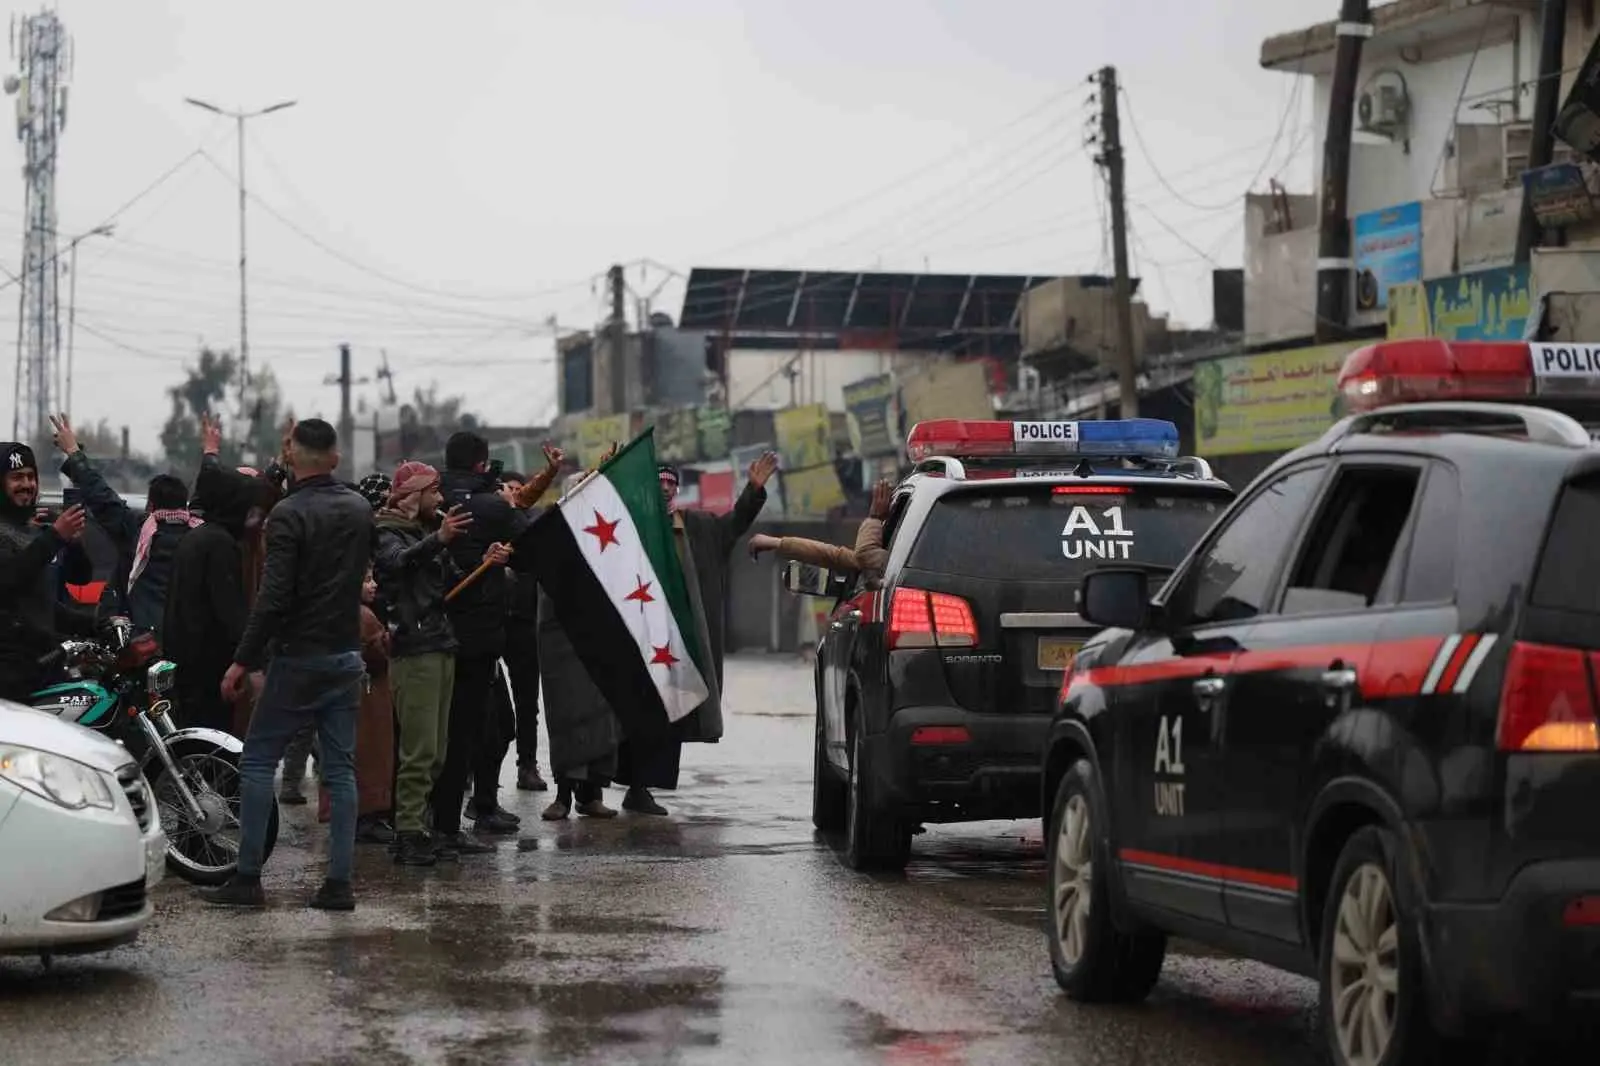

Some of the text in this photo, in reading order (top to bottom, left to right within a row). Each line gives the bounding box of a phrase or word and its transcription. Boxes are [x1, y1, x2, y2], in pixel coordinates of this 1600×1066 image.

[1021, 424, 1072, 439] POLICE
[1061, 505, 1134, 536] A1
[1062, 540, 1134, 560] UNIT
[944, 654, 1003, 664] SORENTO
[1154, 715, 1185, 773] A1
[1154, 782, 1185, 817] UNIT
